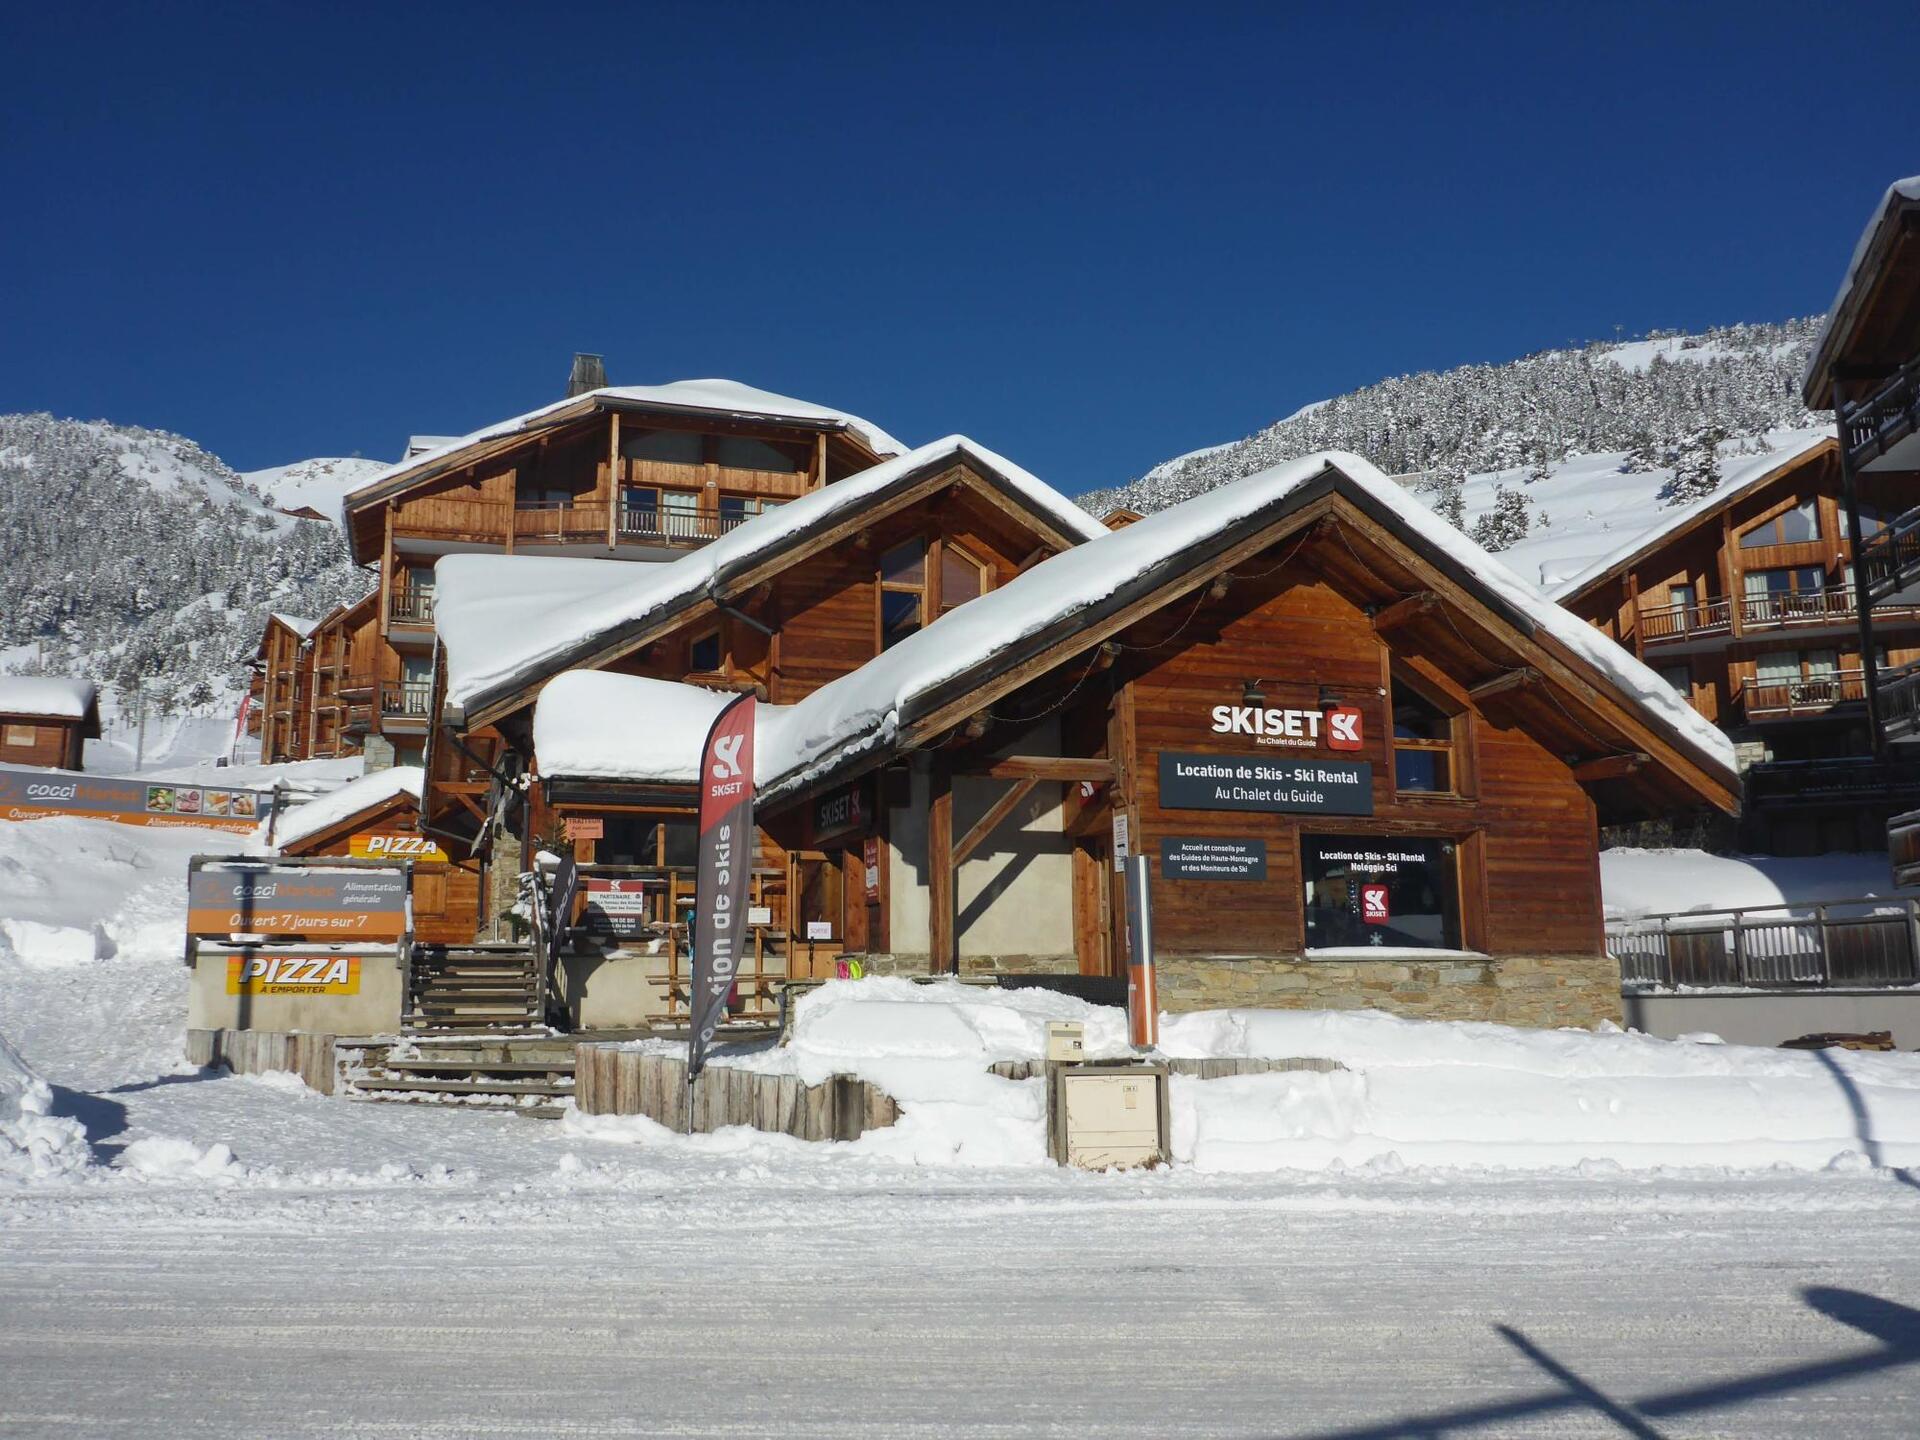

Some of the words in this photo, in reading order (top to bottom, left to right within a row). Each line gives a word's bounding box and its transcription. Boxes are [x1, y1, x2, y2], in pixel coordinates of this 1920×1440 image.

[1211, 705, 1323, 738] SKISET
[1257, 736, 1266, 744] Au
[1266, 737, 1288, 745] Chalet
[1288, 738, 1297, 746] du
[1297, 739, 1317, 747] Guide
[1176, 762, 1233, 778] Location
[1236, 766, 1252, 779] de
[1255, 767, 1282, 780] Skis
[1294, 768, 1314, 782] Ski
[1318, 770, 1359, 784] Rental
[712, 781, 743, 797] SKISET
[1215, 786, 1230, 799] Au
[1233, 787, 1271, 801] Chalet
[1274, 789, 1288, 802] du
[1291, 790, 1324, 803] Guide
[820, 794, 850, 828] SKISET
[366, 836, 437, 854] PIZZA
[1181, 844, 1203, 852] Accueil
[1203, 844, 1211, 852] et
[1211, 845, 1235, 853] conseils
[1235, 846, 1246, 854] par
[715, 825, 731, 887] skis
[1168, 853, 1181, 861] des
[1181, 853, 1202, 861] Guides
[1210, 855, 1259, 865] Haute-Montagne
[1319, 851, 1353, 860] Location
[1353, 852, 1364, 860] de
[1364, 852, 1381, 861] Skis
[1387, 852, 1400, 861] Ski
[1400, 853, 1425, 862] Rental
[1188, 864, 1200, 872] des
[1230, 865, 1238, 873] de
[1238, 865, 1248, 873] Ski
[1351, 863, 1385, 873] Noleggio
[1385, 863, 1397, 872] Sci
[343, 881, 402, 892] Alimentation
[342, 894, 381, 905] générale
[712, 894, 731, 929] de
[229, 913, 277, 927] Ouvert
[281, 914, 292, 927] 7
[291, 915, 328, 930] jours
[331, 919, 353, 927] sur
[357, 915, 368, 928] 7
[238, 958, 348, 984] PIZZA
[270, 986, 326, 994] EMPORTER
